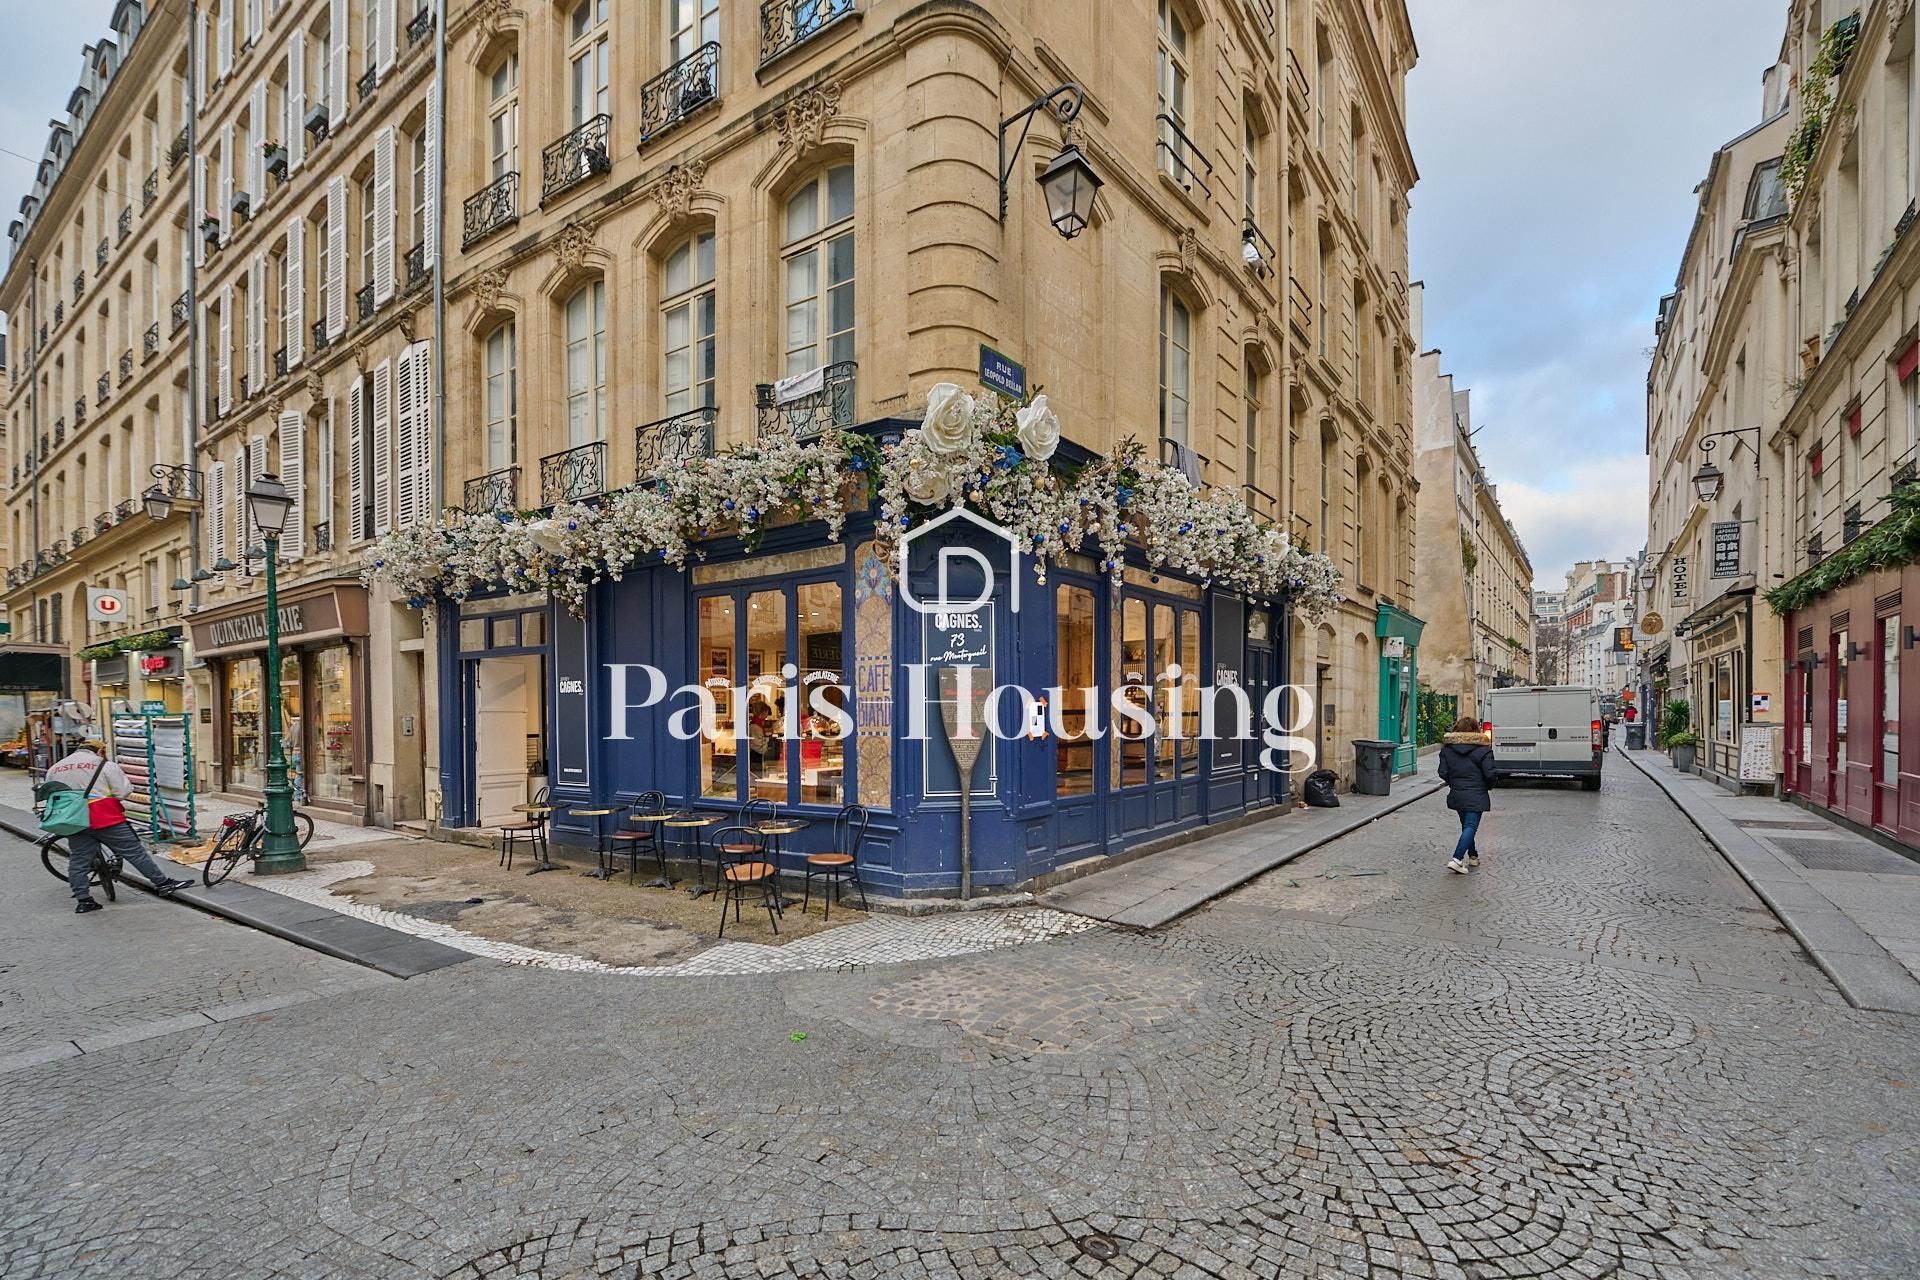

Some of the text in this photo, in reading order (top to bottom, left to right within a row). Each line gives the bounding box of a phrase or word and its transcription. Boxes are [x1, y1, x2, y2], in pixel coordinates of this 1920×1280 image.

[996, 361, 1012, 377] RUE
[1005, 378, 1022, 394] BELLAN
[1673, 557, 1687, 598] HOTEL
[100, 601, 115, 611] U
[210, 605, 303, 647] QUINCAILLRIE
[935, 613, 983, 629] CAGNES.
[950, 632, 965, 648] 73
[802, 670, 841, 686] CHOCOLATERIE
[858, 664, 890, 692] CAFE
[560, 680, 584, 694] CAGNES.
[857, 696, 891, 727] BIARD
[54, 762, 97, 774] JUST EAT
